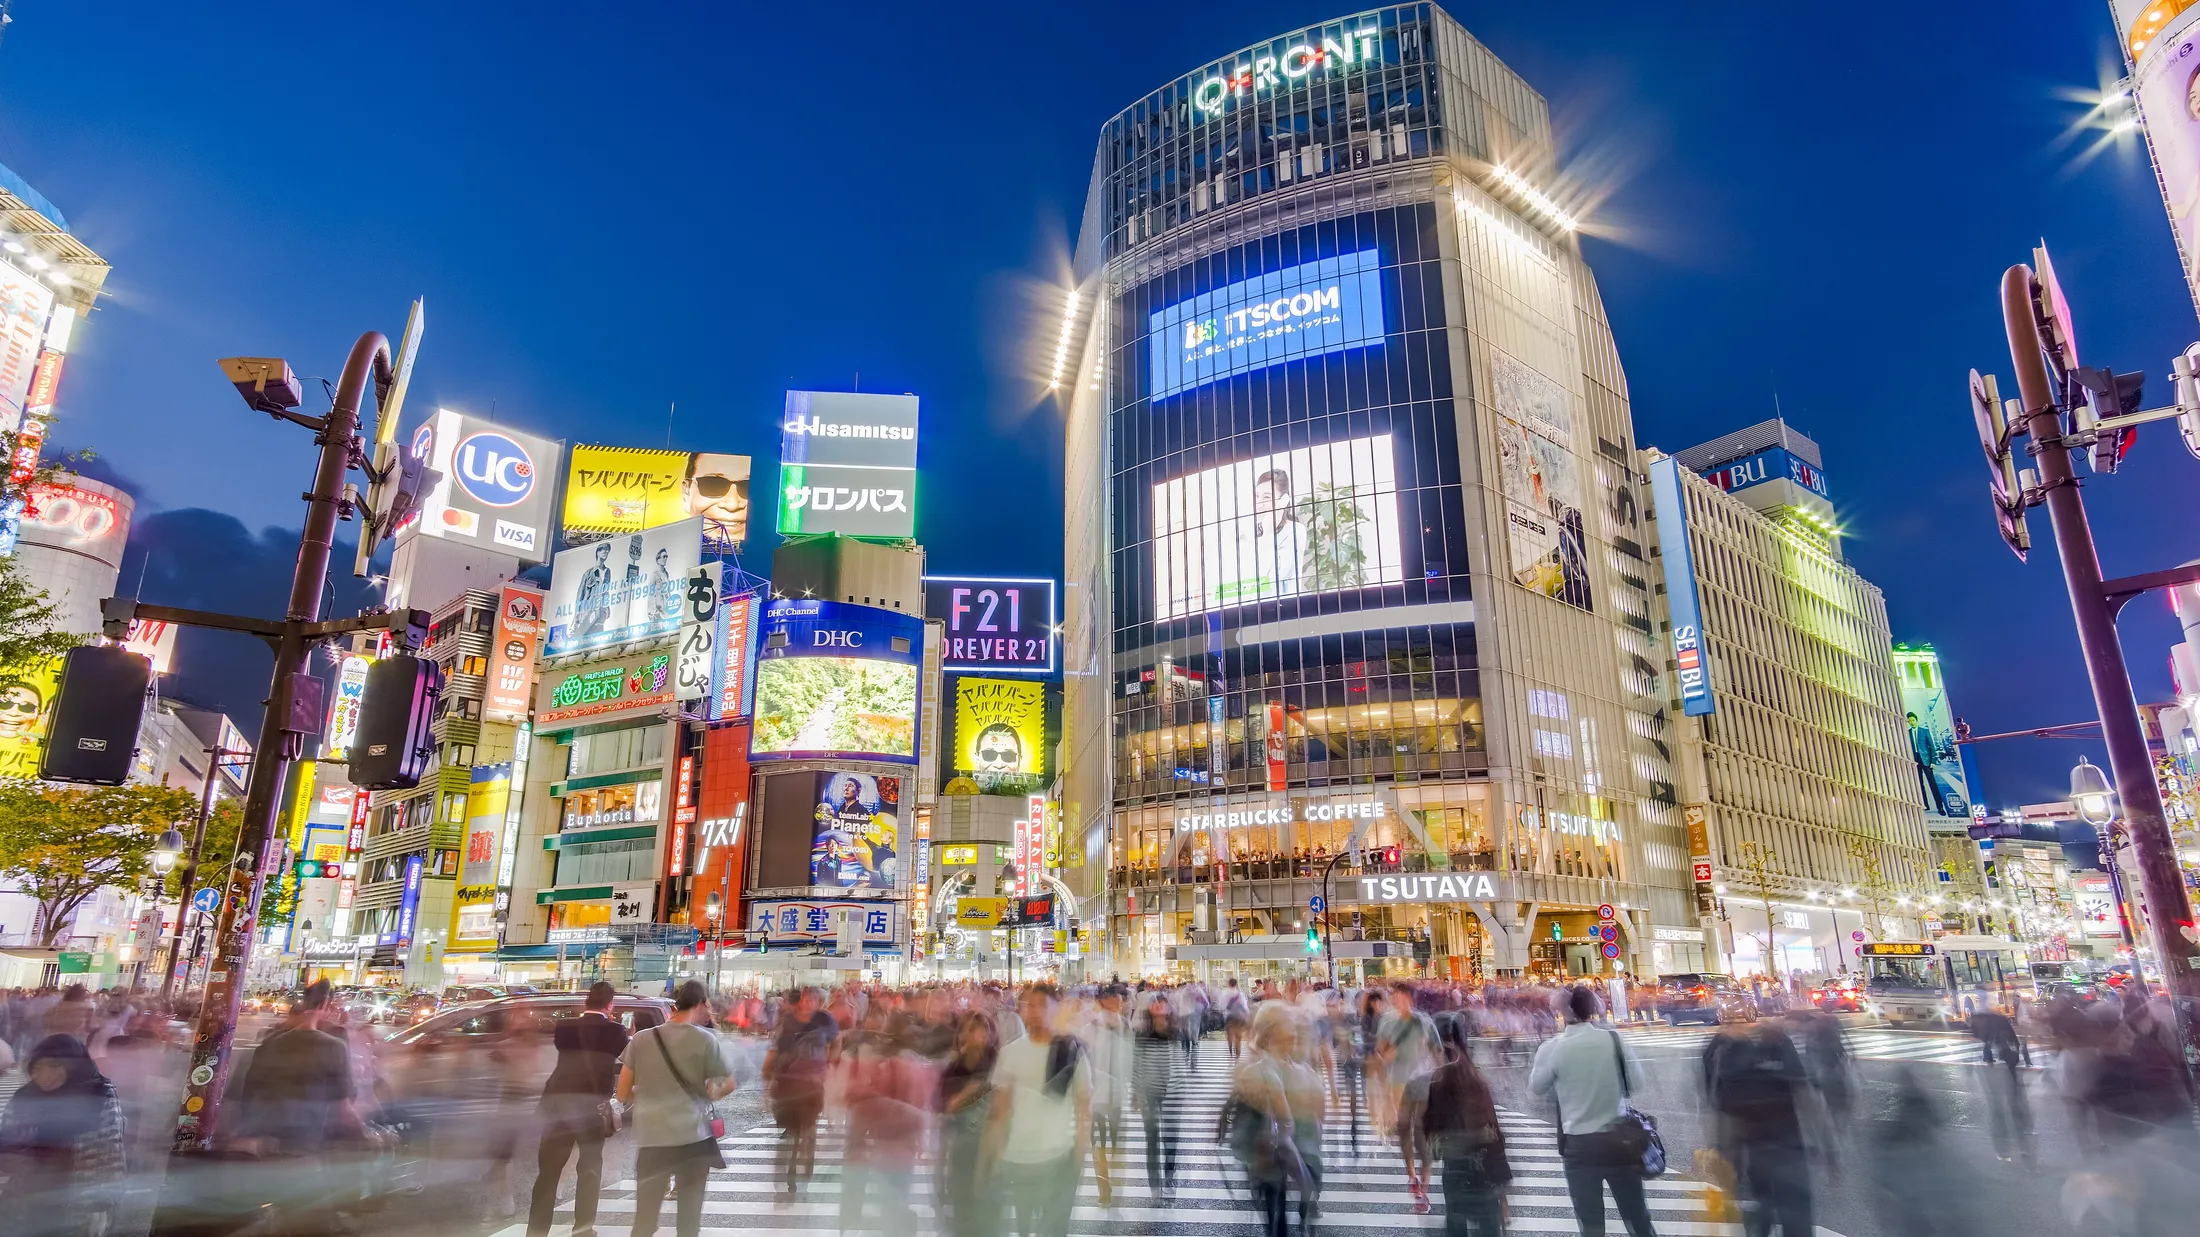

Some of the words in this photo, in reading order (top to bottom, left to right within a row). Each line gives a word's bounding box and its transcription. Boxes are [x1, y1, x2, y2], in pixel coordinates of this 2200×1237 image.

[1195, 27, 1377, 116] QFRONT
[784, 415, 915, 440] Hisamitsu
[578, 469, 679, 492] ヤバババーン
[1717, 457, 1768, 490] IBU
[41, 484, 117, 511] SHIBUYA
[786, 485, 907, 513] サロンパス
[499, 526, 533, 545] VISA
[555, 604, 573, 618] ALL
[602, 590, 630, 608] BEST
[631, 583, 656, 599] 1998
[661, 576, 687, 594] 2018
[952, 588, 1020, 632] F21
[767, 609, 784, 617] DHC
[786, 607, 819, 616] Channel
[679, 567, 717, 694] もんじゃ
[813, 630, 863, 647] DHC
[943, 637, 1019, 660] OREVER
[1025, 639, 1046, 661] 21
[1674, 625, 1704, 700] SEIBU
[582, 677, 624, 703] 西村
[961, 684, 1039, 706] ヤバババーン
[567, 808, 632, 829] Euphoria
[831, 818, 882, 834] Planets
[839, 811, 869, 820] teamLab
[1180, 807, 1293, 832] STARBUCKS
[1305, 801, 1385, 821] COFFEE
[1549, 811, 1621, 846] TSUTAYA
[701, 817, 742, 847] クスリ
[1031, 803, 1043, 857] カラオケ
[1016, 863, 1026, 897] カラオ
[1697, 866, 1710, 878] 本
[1362, 875, 1496, 899] TSUTAYA
[758, 908, 889, 934] 大盛堂店
